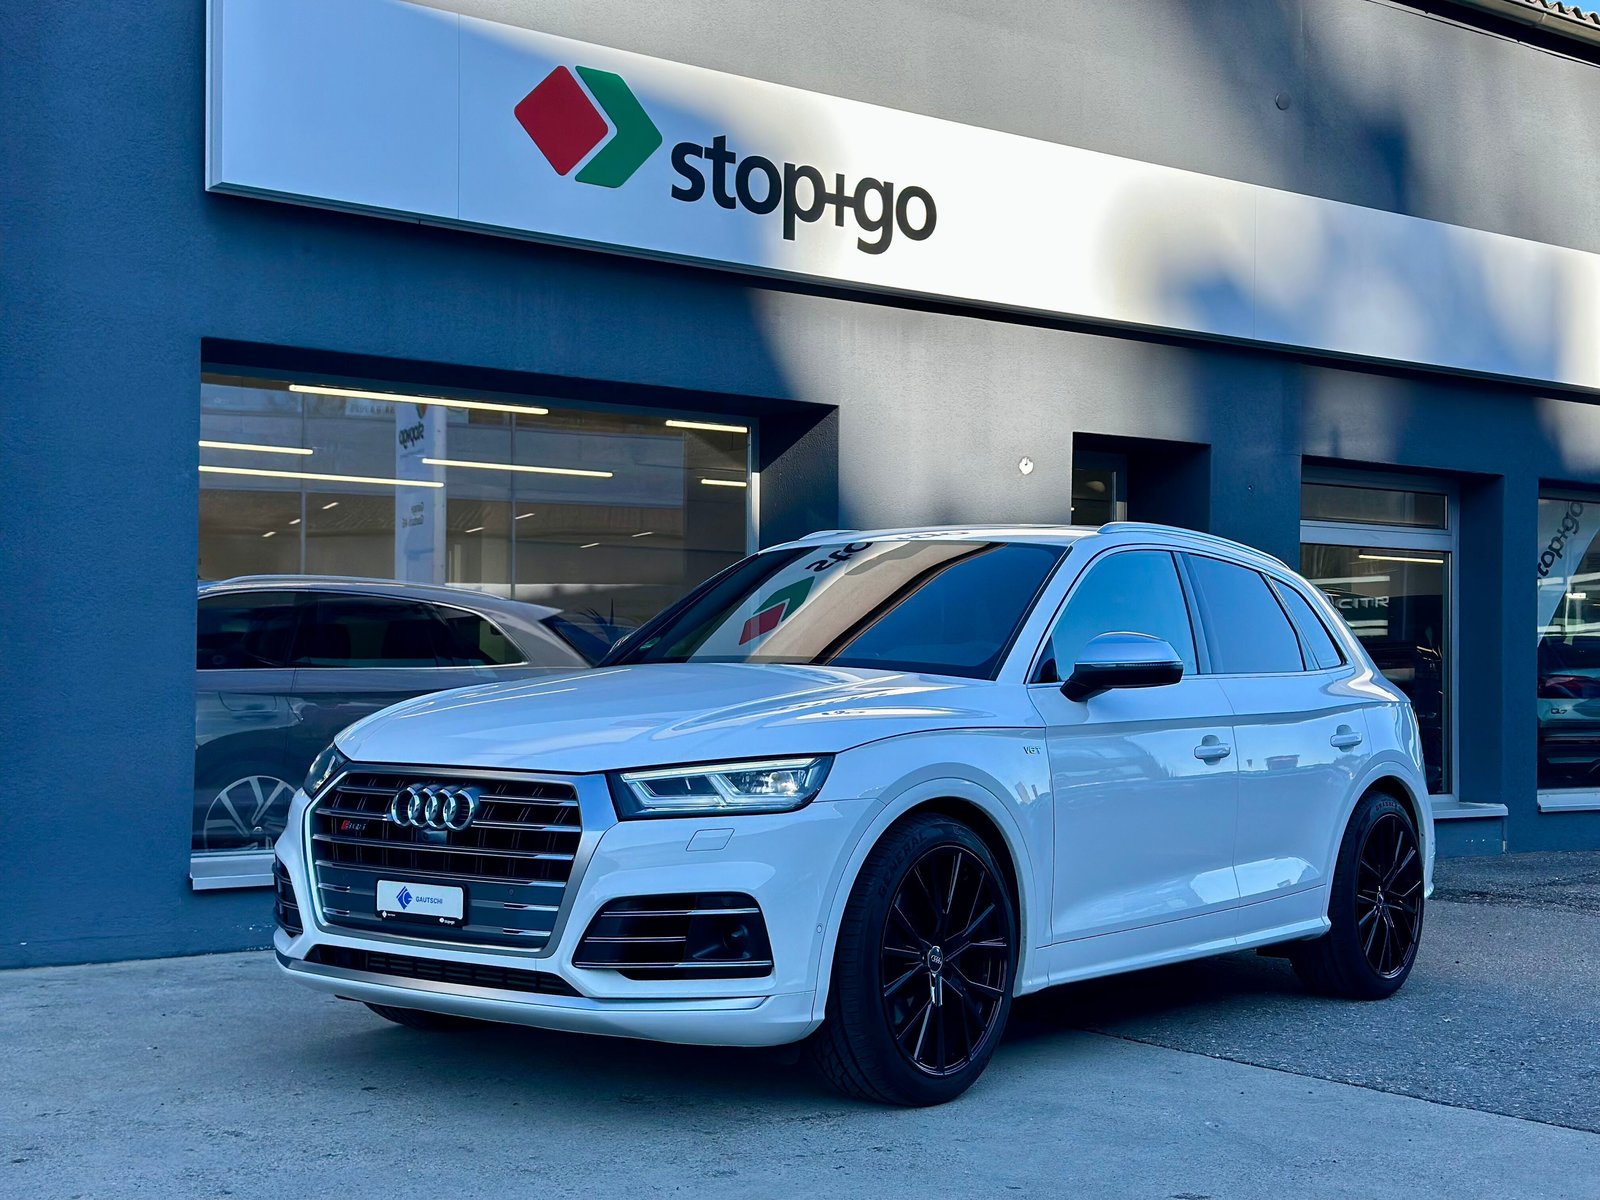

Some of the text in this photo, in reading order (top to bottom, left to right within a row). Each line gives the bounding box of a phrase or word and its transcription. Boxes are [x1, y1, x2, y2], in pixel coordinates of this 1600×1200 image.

[670, 134, 938, 256] stop+go
[1537, 501, 1584, 580] top+go
[415, 896, 443, 905] GAUTSCHI
